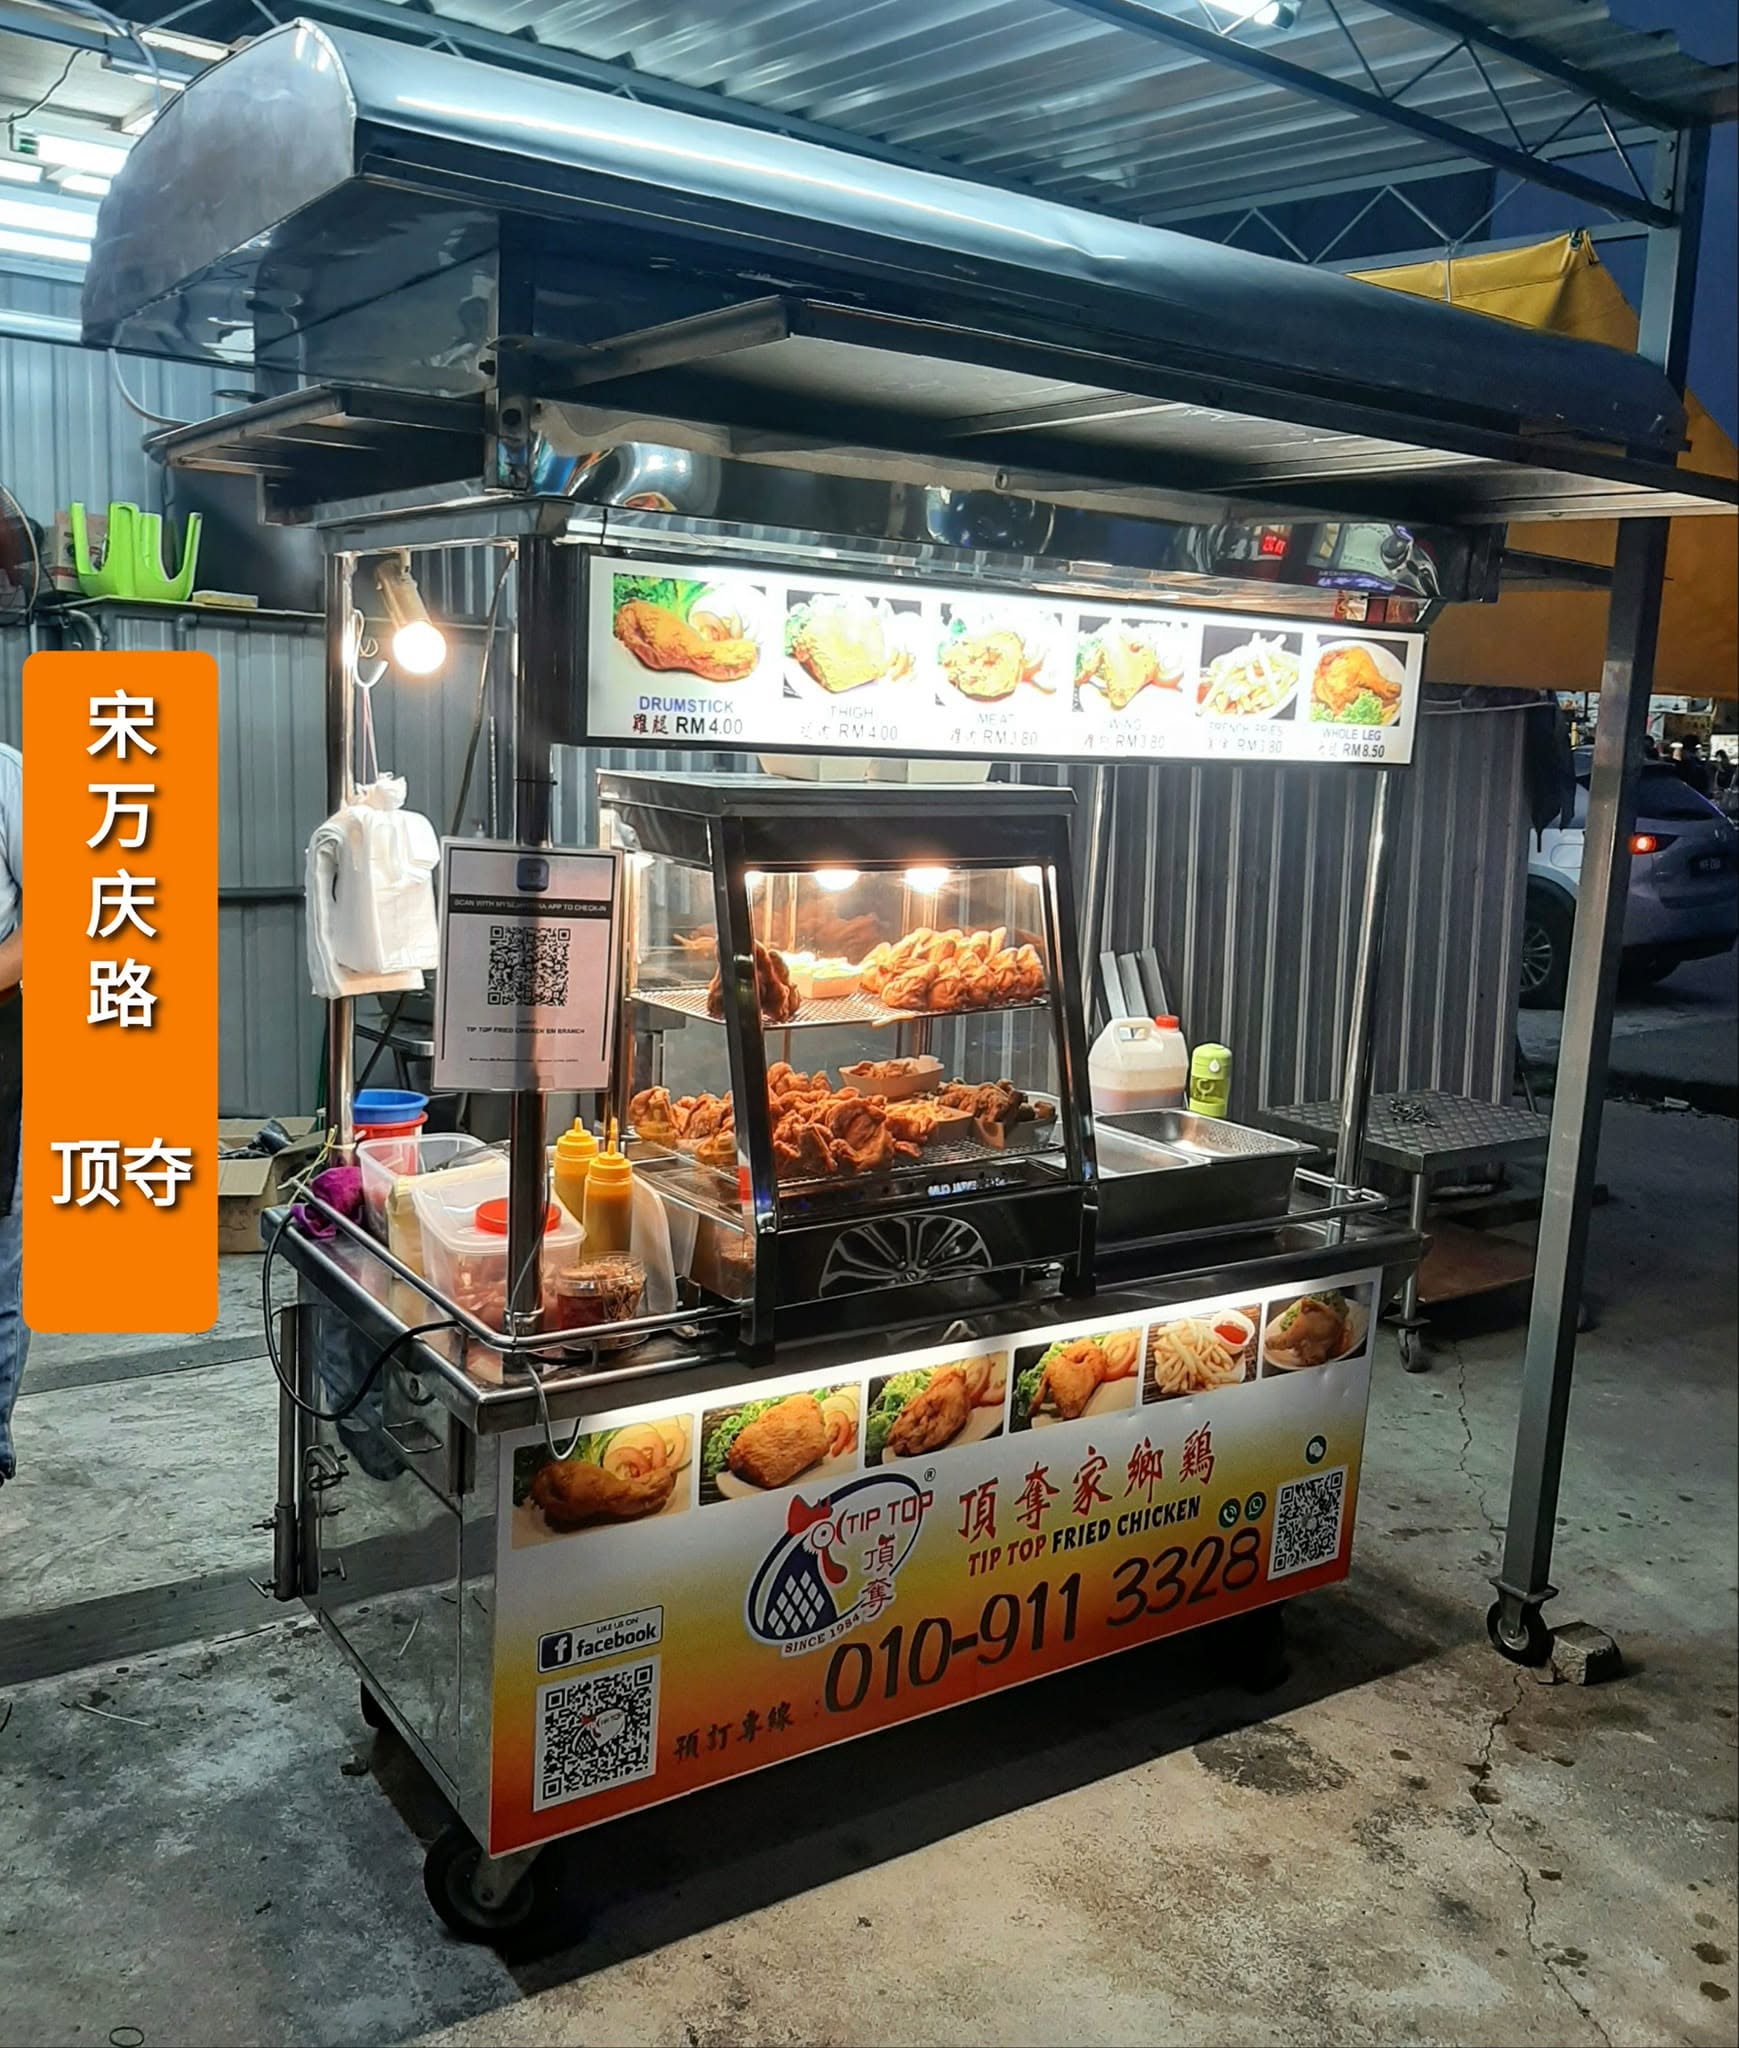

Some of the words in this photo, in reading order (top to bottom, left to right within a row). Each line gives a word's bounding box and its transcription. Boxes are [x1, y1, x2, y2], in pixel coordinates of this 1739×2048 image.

[639, 696, 734, 713] DRUMSTICK
[830, 705, 874, 719] THIGH
[838, 723, 898, 741] RM400
[1322, 728, 1358, 740] WHOLE
[1361, 729, 1382, 741] LEG
[1115, 734, 1166, 749] RM380
[1342, 742, 1385, 758] RM8.50
[454, 898, 475, 907] SCAN
[475, 899, 495, 908] WITH
[547, 903, 562, 911] APP
[563, 903, 573, 911] TO
[846, 1507, 881, 1534] TIP
[887, 1490, 934, 1526] TOP
[968, 1547, 1002, 1577] TIP
[1007, 1534, 1047, 1566] TOP
[1051, 1516, 1111, 1554] FRIED
[1116, 1495, 1201, 1537] CHICKEN
[596, 1623, 613, 1634] LIKE
[613, 1619, 625, 1629] US
[625, 1616, 639, 1626] ON
[824, 1572, 1081, 1713] 010-911
[1106, 1526, 1262, 1628] 3328
[576, 1622, 657, 1658] facebook
[784, 1632, 826, 1654] SINCE
[829, 1612, 860, 1639] 1984
